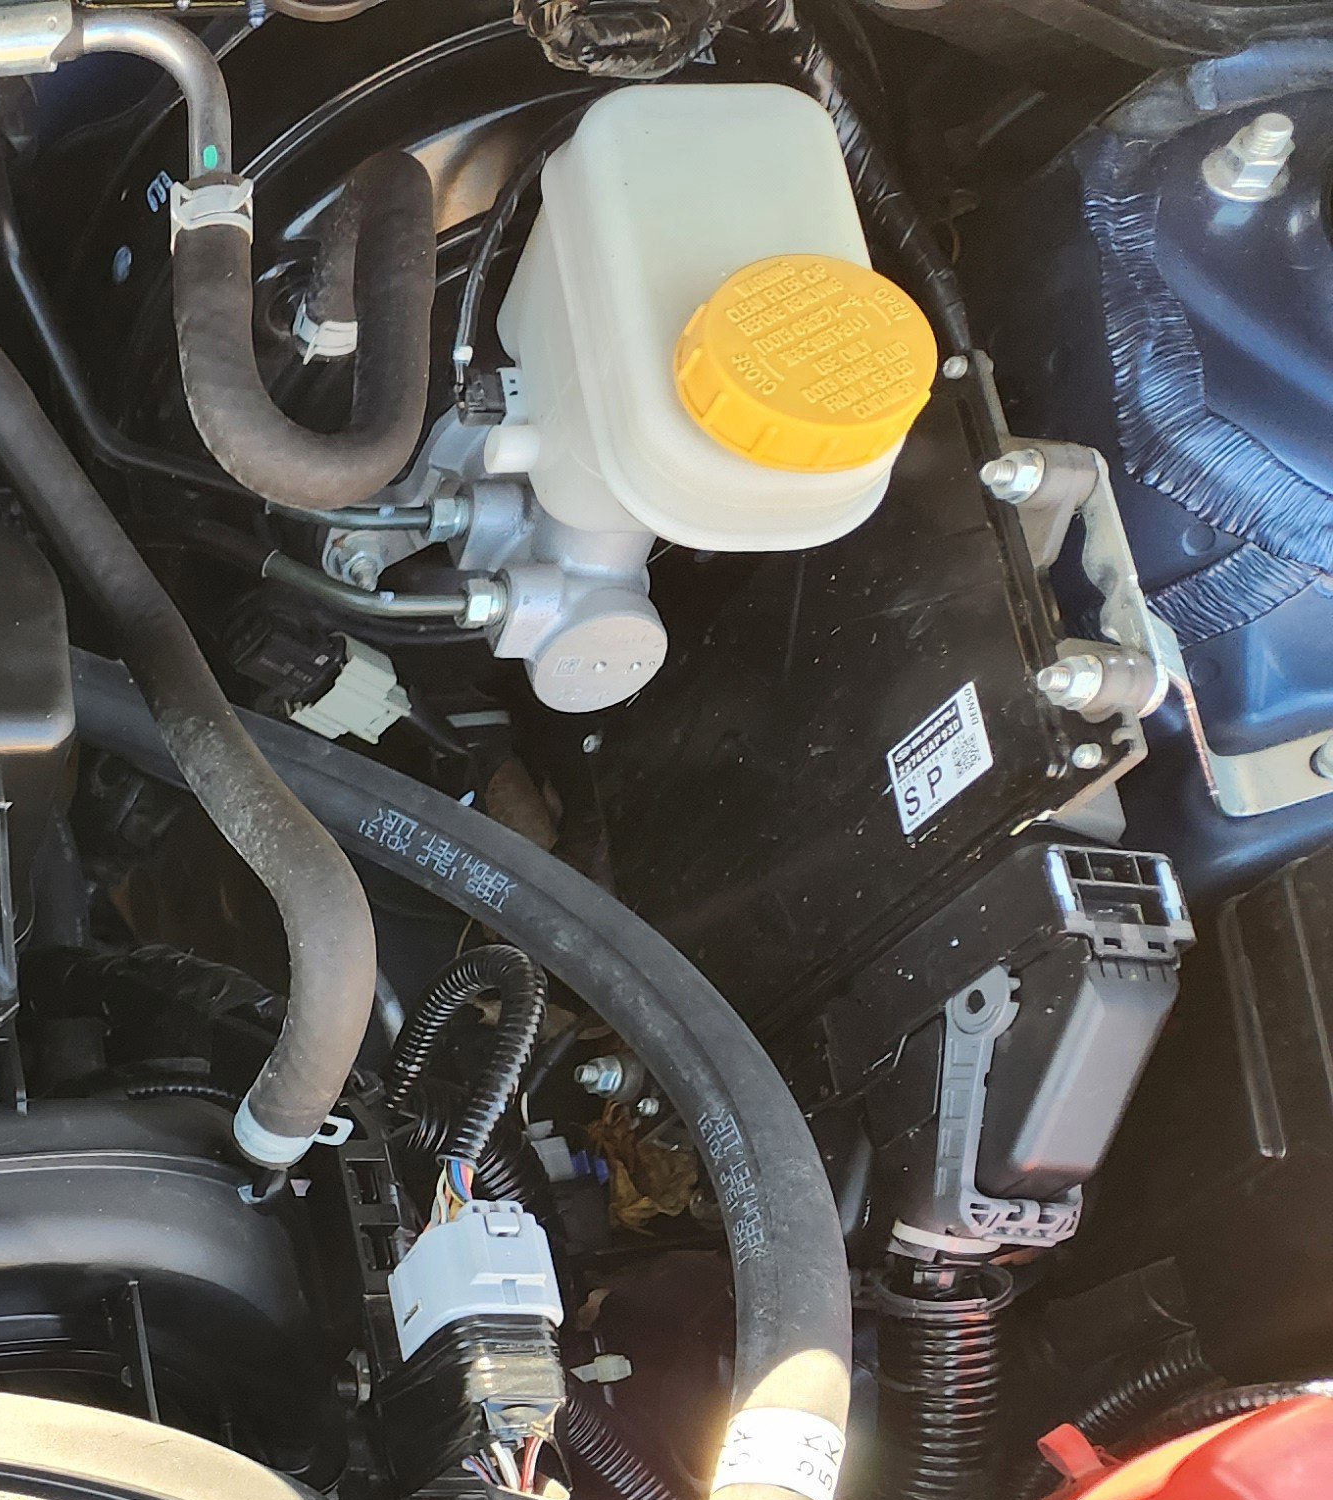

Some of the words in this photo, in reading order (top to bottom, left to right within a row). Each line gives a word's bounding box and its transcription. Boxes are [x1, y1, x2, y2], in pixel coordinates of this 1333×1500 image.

[725, 292, 767, 323] CLEAN
[764, 276, 805, 304] FILLER
[800, 263, 828, 285] CAP
[874, 287, 912, 321] OPEN
[737, 304, 787, 337] BEFORE
[731, 351, 778, 395] CLOSE
[812, 353, 841, 377] USE
[838, 340, 873, 363] ONLY
[836, 357, 879, 386] BRAKE
[874, 340, 910, 366] FLUID
[821, 387, 865, 414] FROM
[861, 379, 876, 395] A
[871, 359, 916, 389] SEALED
[963, 687, 979, 725] DENSO
[904, 785, 921, 816] S
[927, 765, 943, 799] P
